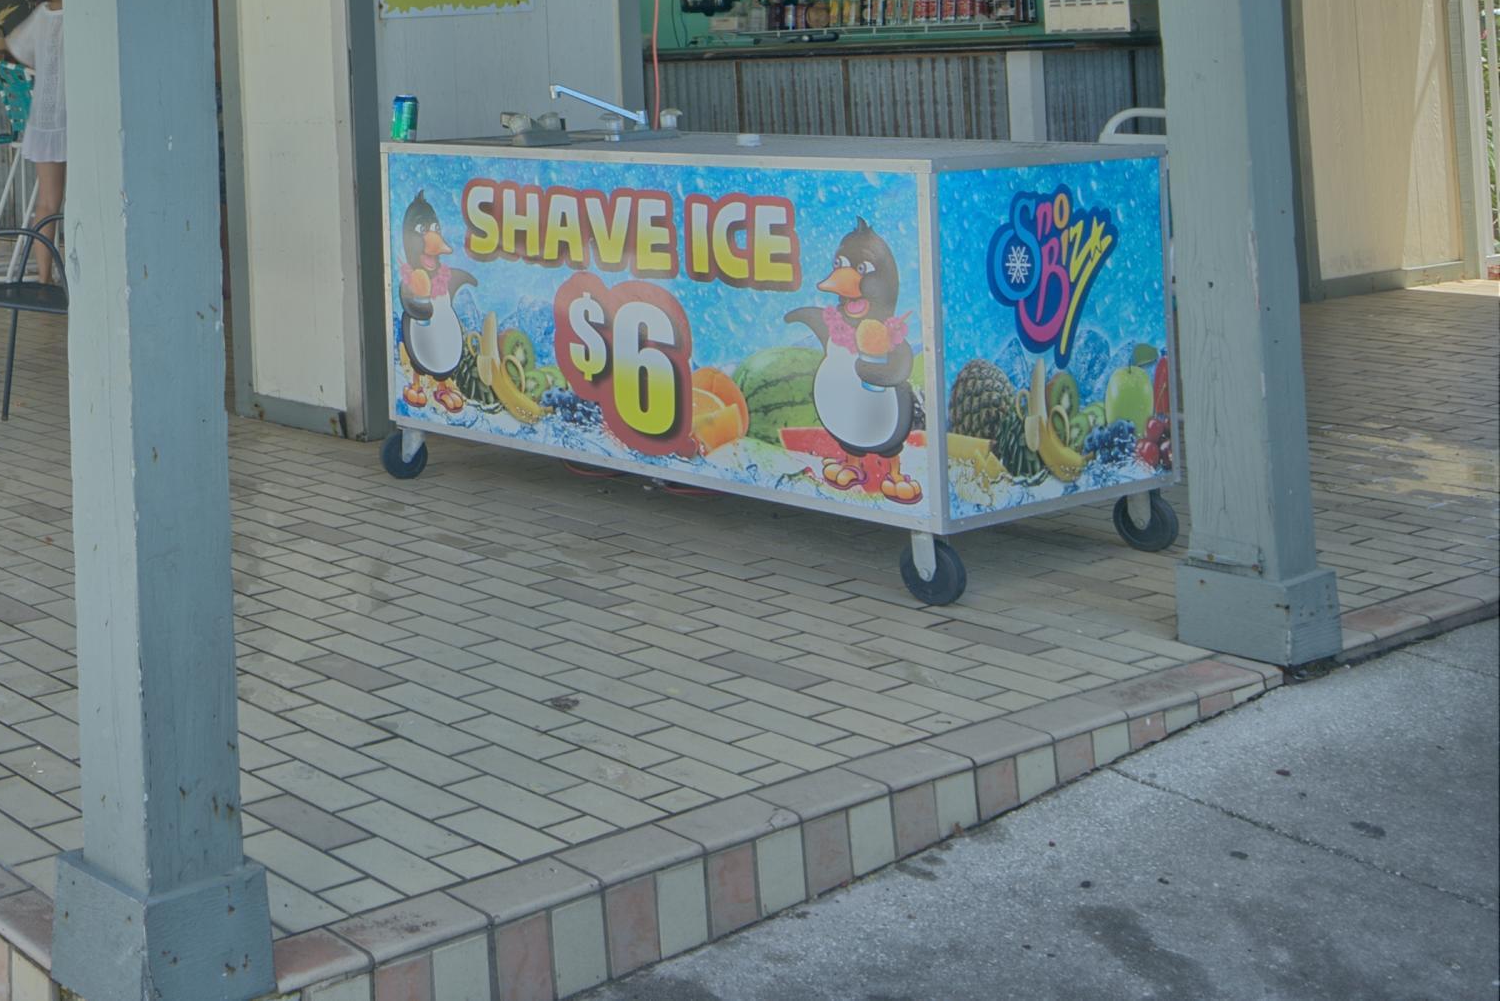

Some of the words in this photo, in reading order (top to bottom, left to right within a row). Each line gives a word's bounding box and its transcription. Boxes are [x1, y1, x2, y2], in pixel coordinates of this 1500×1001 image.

[467, 186, 672, 271] SHAVE
[692, 202, 793, 282] ICE
[994, 193, 1070, 301] Sno
[569, 292, 675, 435] $6
